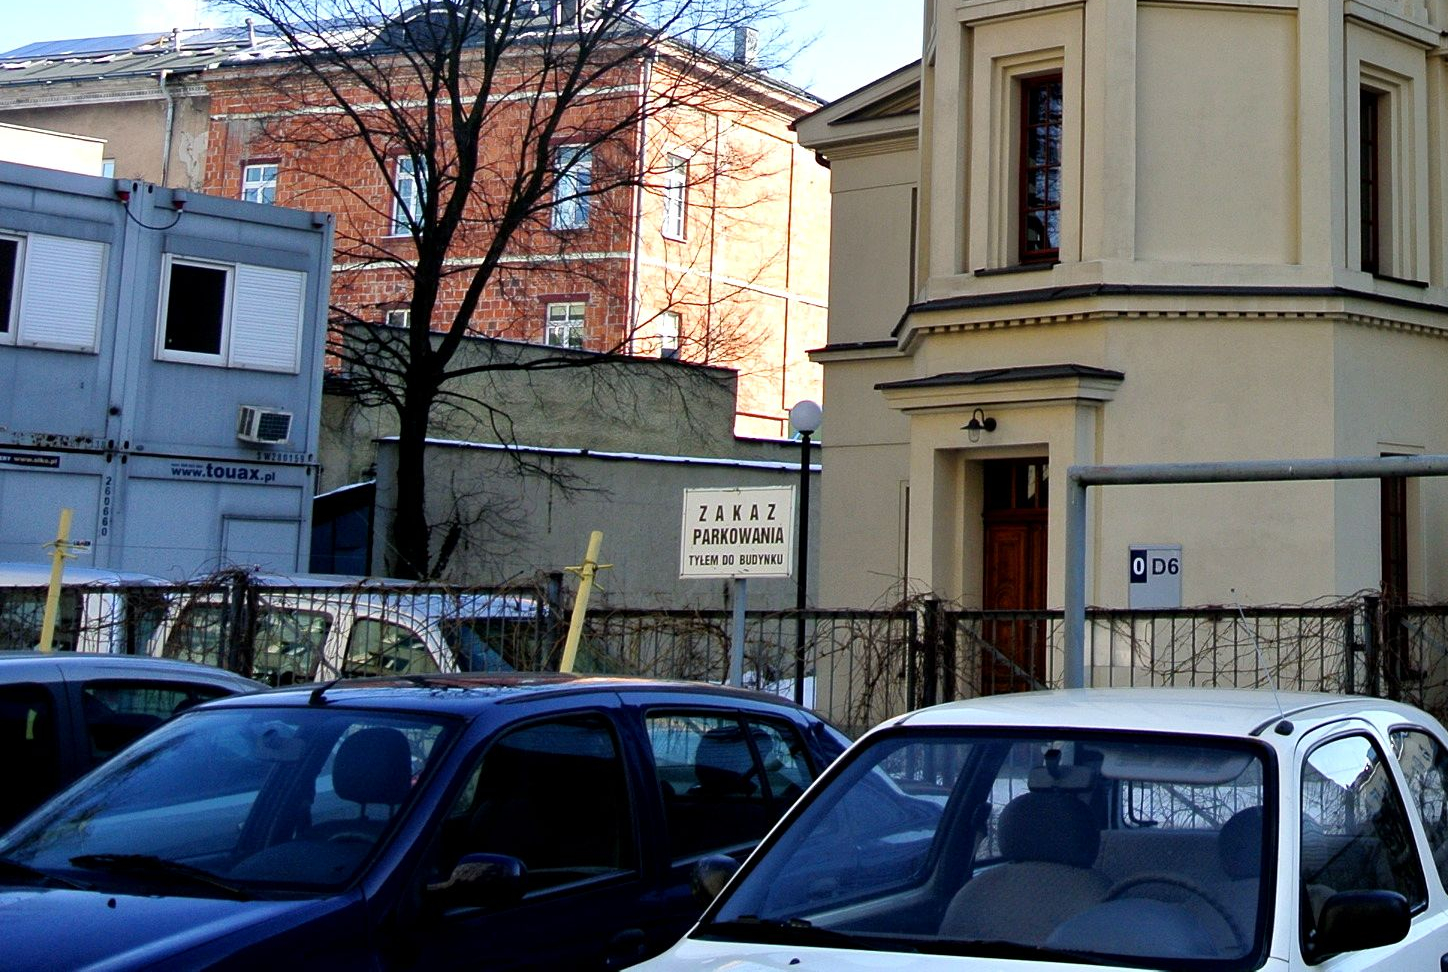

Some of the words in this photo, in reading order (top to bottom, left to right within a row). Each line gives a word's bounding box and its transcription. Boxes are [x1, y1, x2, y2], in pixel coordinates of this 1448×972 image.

[171, 463, 276, 482] www.touax.pl
[699, 503, 777, 522] ZAKAZ
[693, 526, 784, 545] PARKOWANIA
[689, 555, 719, 566] TYŁEM
[722, 554, 735, 566] DO
[740, 554, 783, 565] BUDYNKU
[1152, 557, 1179, 575] D6
